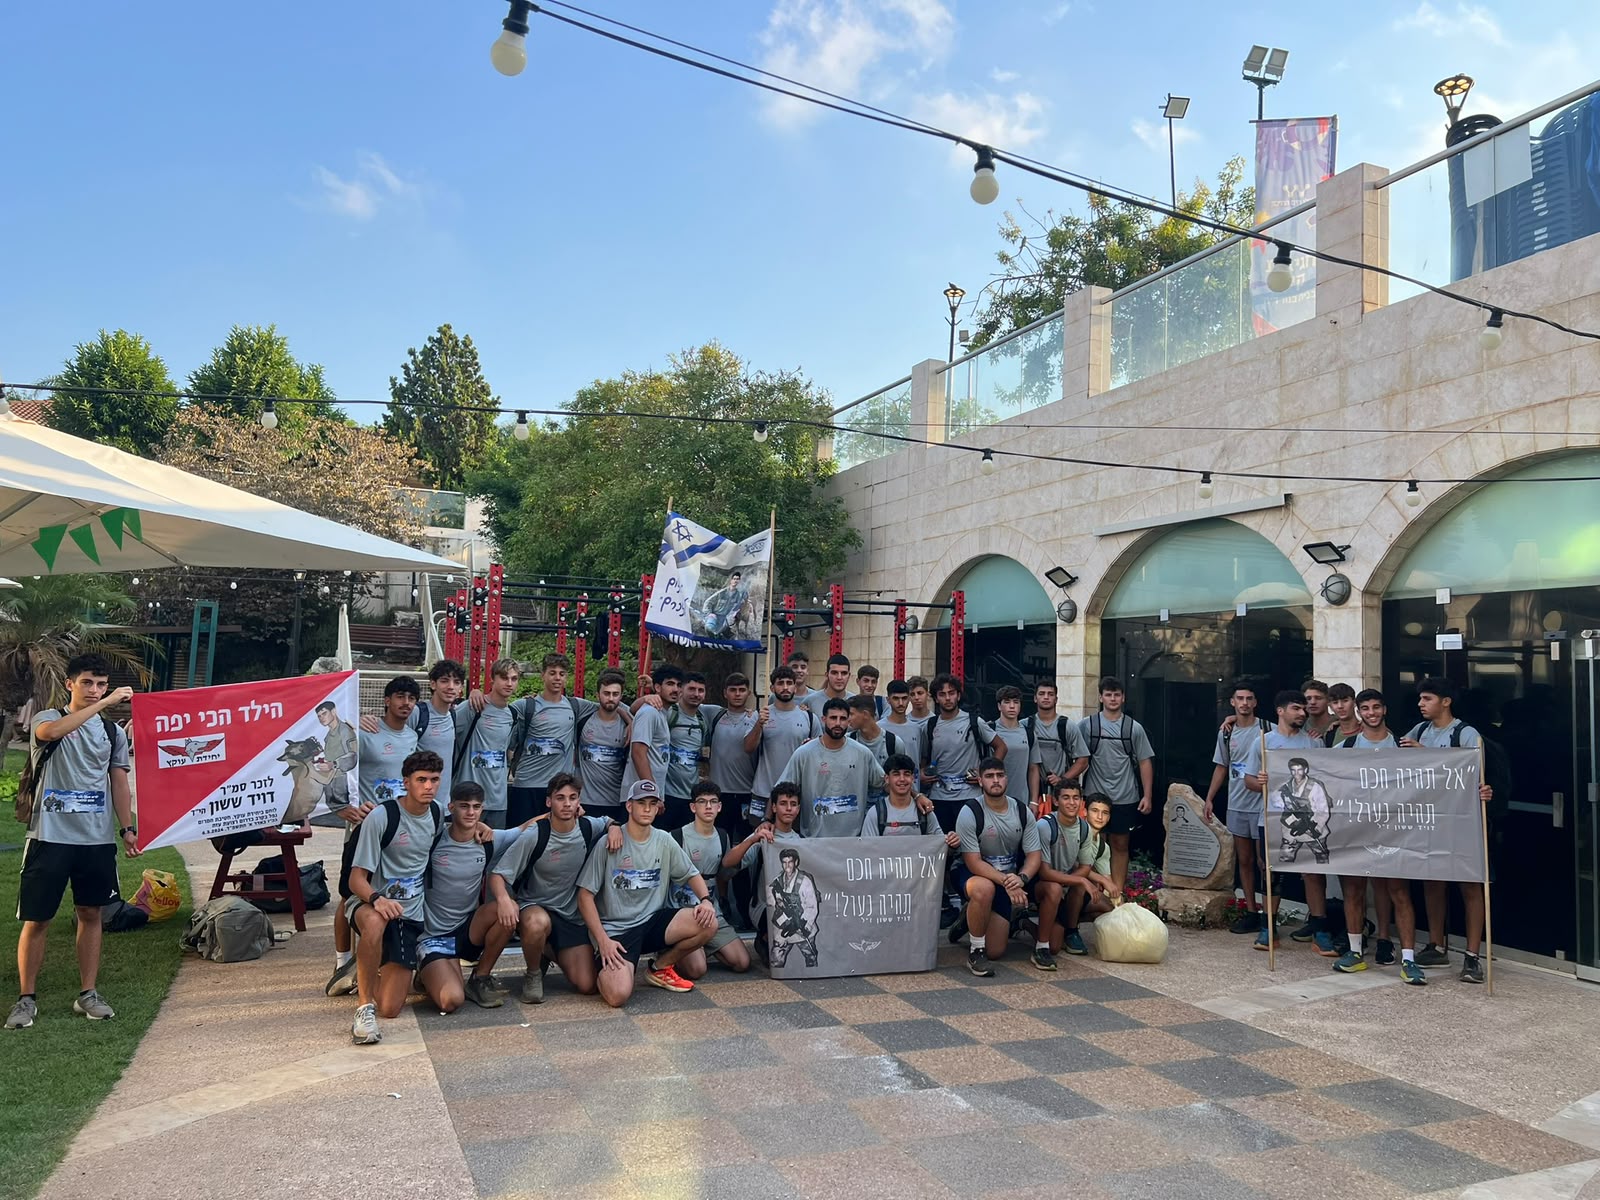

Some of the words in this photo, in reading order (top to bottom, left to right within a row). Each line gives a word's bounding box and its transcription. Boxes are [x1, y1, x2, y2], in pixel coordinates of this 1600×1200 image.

[198, 708, 232, 728] הכי
[238, 699, 283, 723] הילד
[155, 713, 191, 733] יפה
[166, 758, 187, 768] עוקץ
[196, 753, 220, 763] יחידת
[250, 775, 274, 790] לזכר
[1359, 767, 1389, 789] חכם
[1396, 767, 1436, 790] תהיה
[209, 796, 242, 816] ששון
[247, 791, 275, 806] דויד
[1397, 803, 1435, 824] תהיה
[846, 857, 873, 882] חכם
[879, 856, 913, 879] תהיה
[879, 893, 912, 916] תהיה
